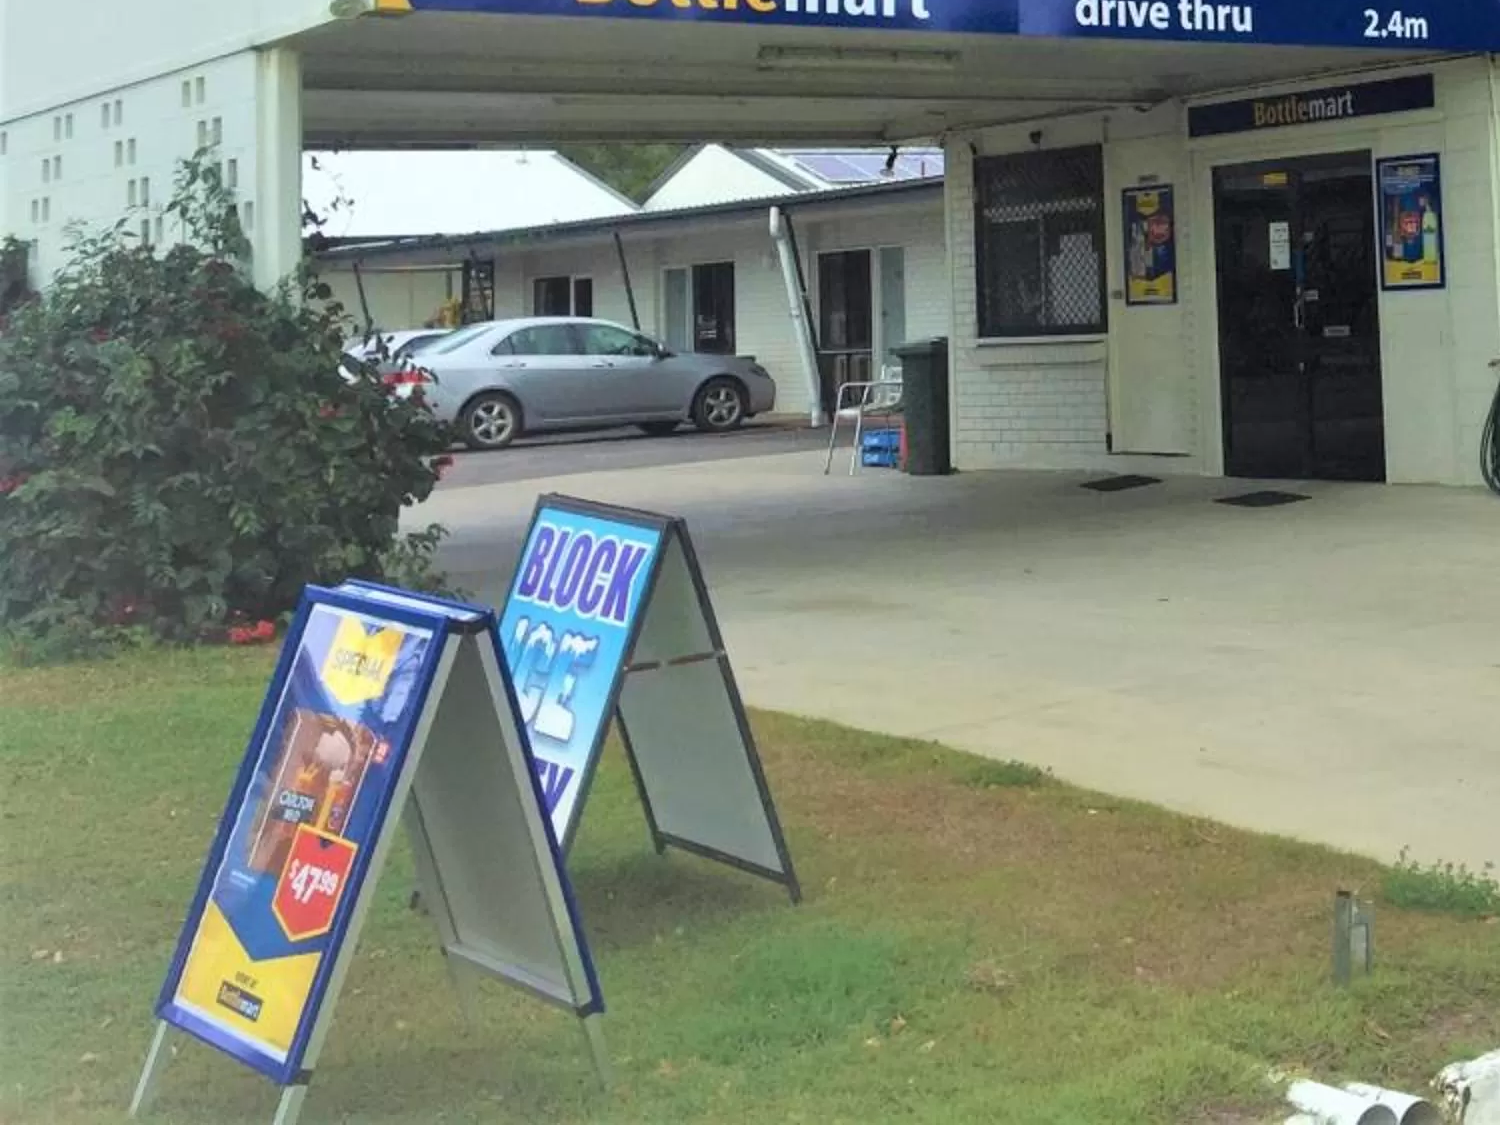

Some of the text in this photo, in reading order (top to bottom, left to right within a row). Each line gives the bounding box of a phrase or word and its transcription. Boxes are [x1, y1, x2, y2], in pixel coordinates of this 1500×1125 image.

[1363, 9, 1429, 39] 2.4m
[1254, 90, 1354, 125] Bottlemart
[516, 523, 648, 623] BLOCK
